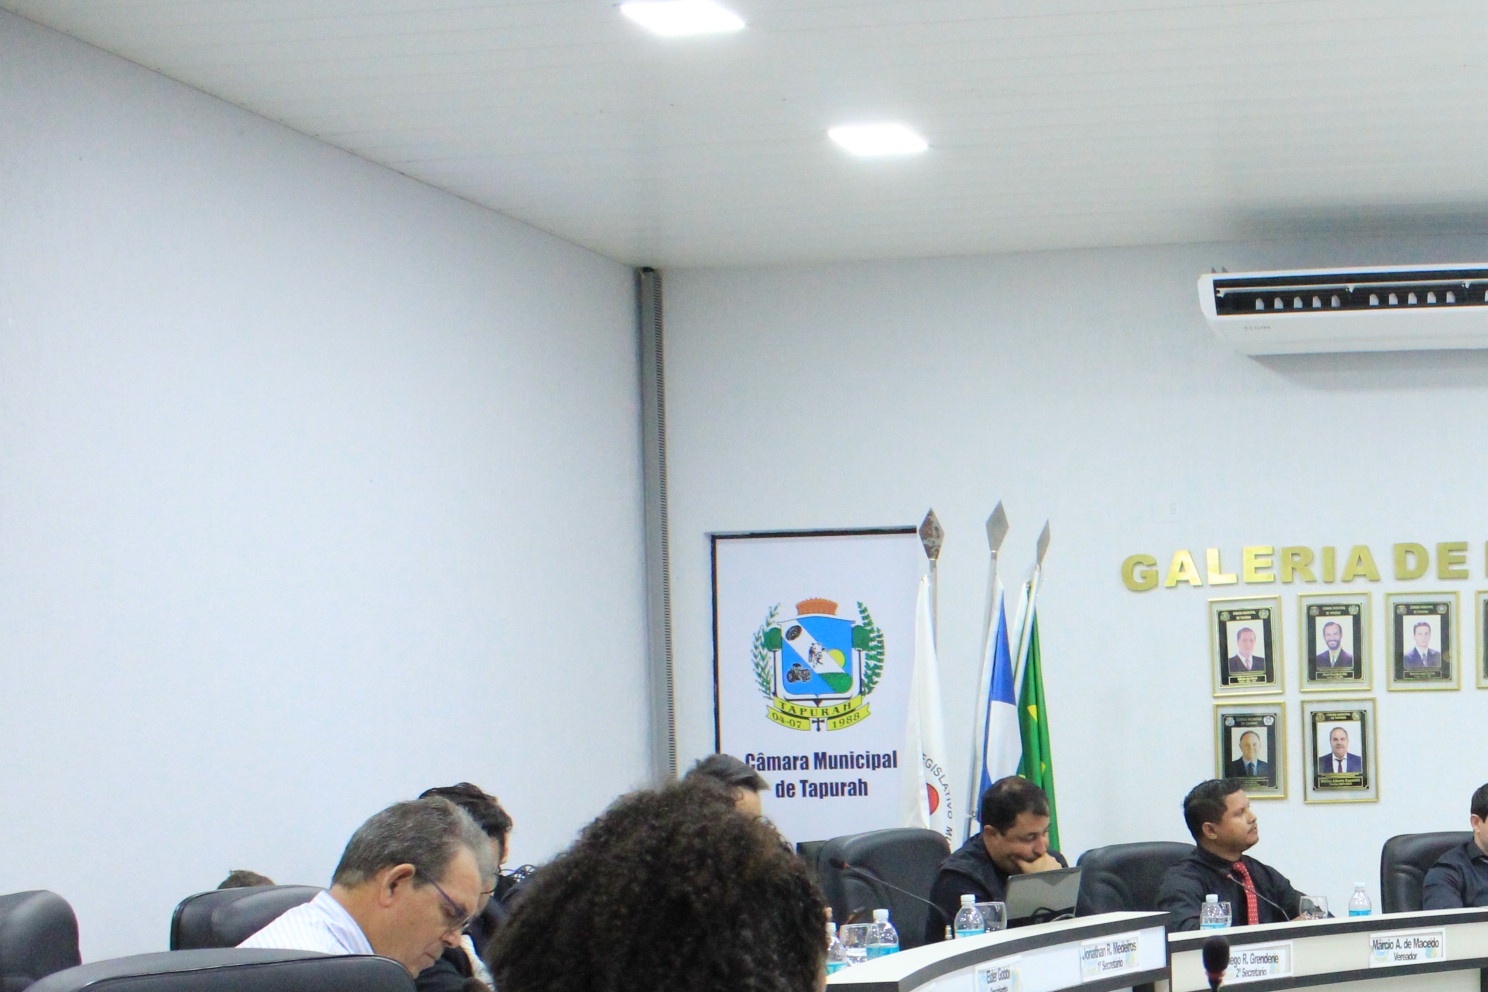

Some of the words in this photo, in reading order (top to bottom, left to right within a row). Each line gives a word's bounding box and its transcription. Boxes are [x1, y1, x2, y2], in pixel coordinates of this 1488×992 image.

[1121, 545, 1381, 592] GALERIA
[1394, 541, 1469, 580] DE
[780, 701, 852, 716] TAPURAH
[772, 712, 802, 729] 04-07
[832, 712, 861, 728] 1988
[745, 752, 809, 771] Câmara
[814, 750, 897, 771] Municipal
[775, 780, 796, 798] de
[800, 778, 868, 799] Tapurah
[1107, 943, 1112, 956] R.
[1395, 938, 1402, 950] A.
[1403, 938, 1412, 949] de
[1413, 937, 1439, 949] Macedo
[1242, 953, 1248, 965] R.
[1394, 951, 1417, 961] Vereador
